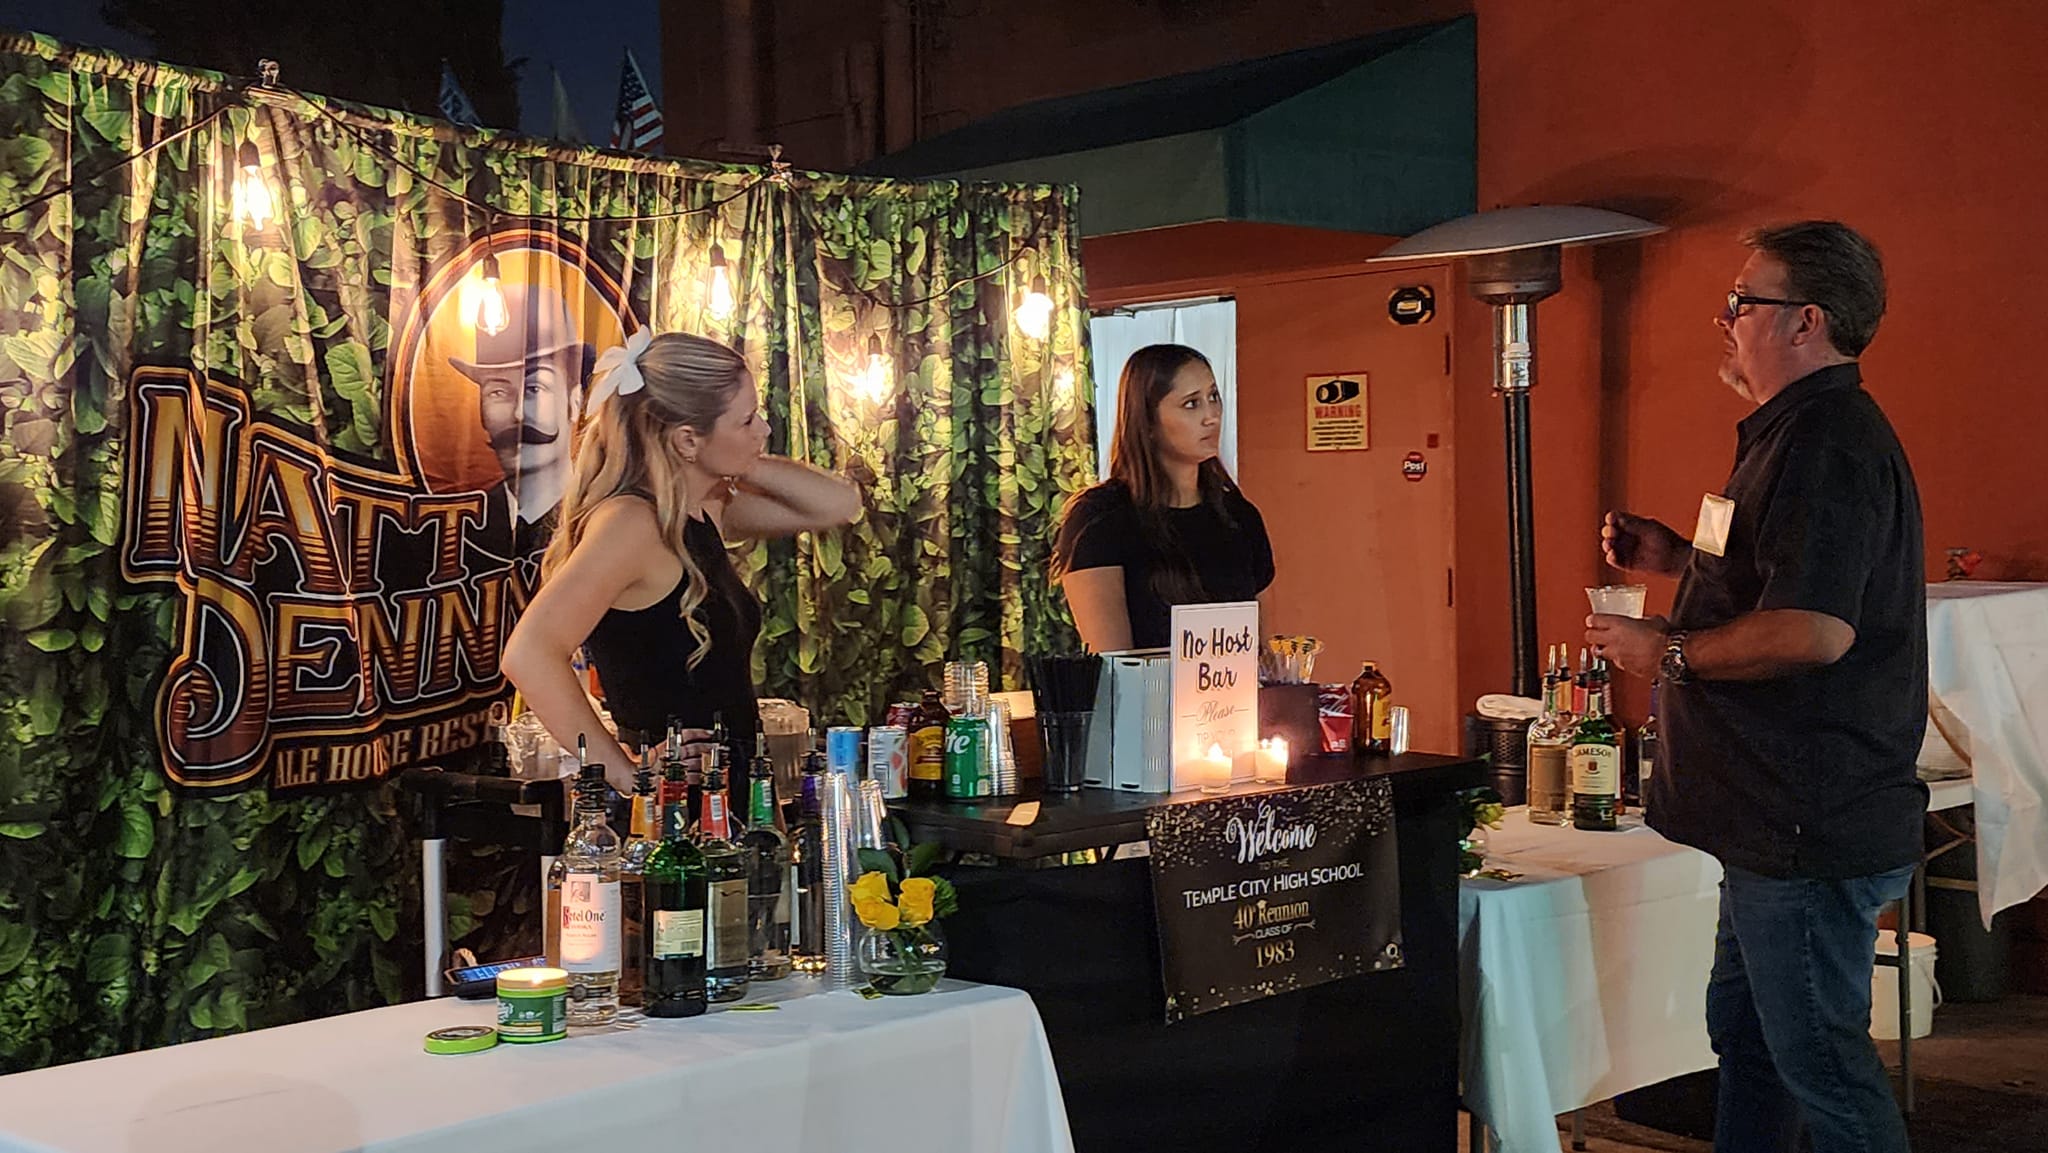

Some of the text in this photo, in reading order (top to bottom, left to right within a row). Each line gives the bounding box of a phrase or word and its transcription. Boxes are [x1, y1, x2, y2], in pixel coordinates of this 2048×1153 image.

[1183, 626, 1253, 659] No Host
[1197, 662, 1237, 691] Bar
[1196, 700, 1235, 726] Please
[274, 746, 321, 789] ALE
[1226, 801, 1317, 864] Welcome
[1258, 858, 1290, 871] TO THE
[1183, 862, 1364, 909] TEMPLE CITY HIGH SCHOOL
[585, 908, 604, 922] One
[1258, 900, 1310, 926] Reunion
[1255, 923, 1294, 939] CLASS OF
[1256, 940, 1295, 968] 1983
